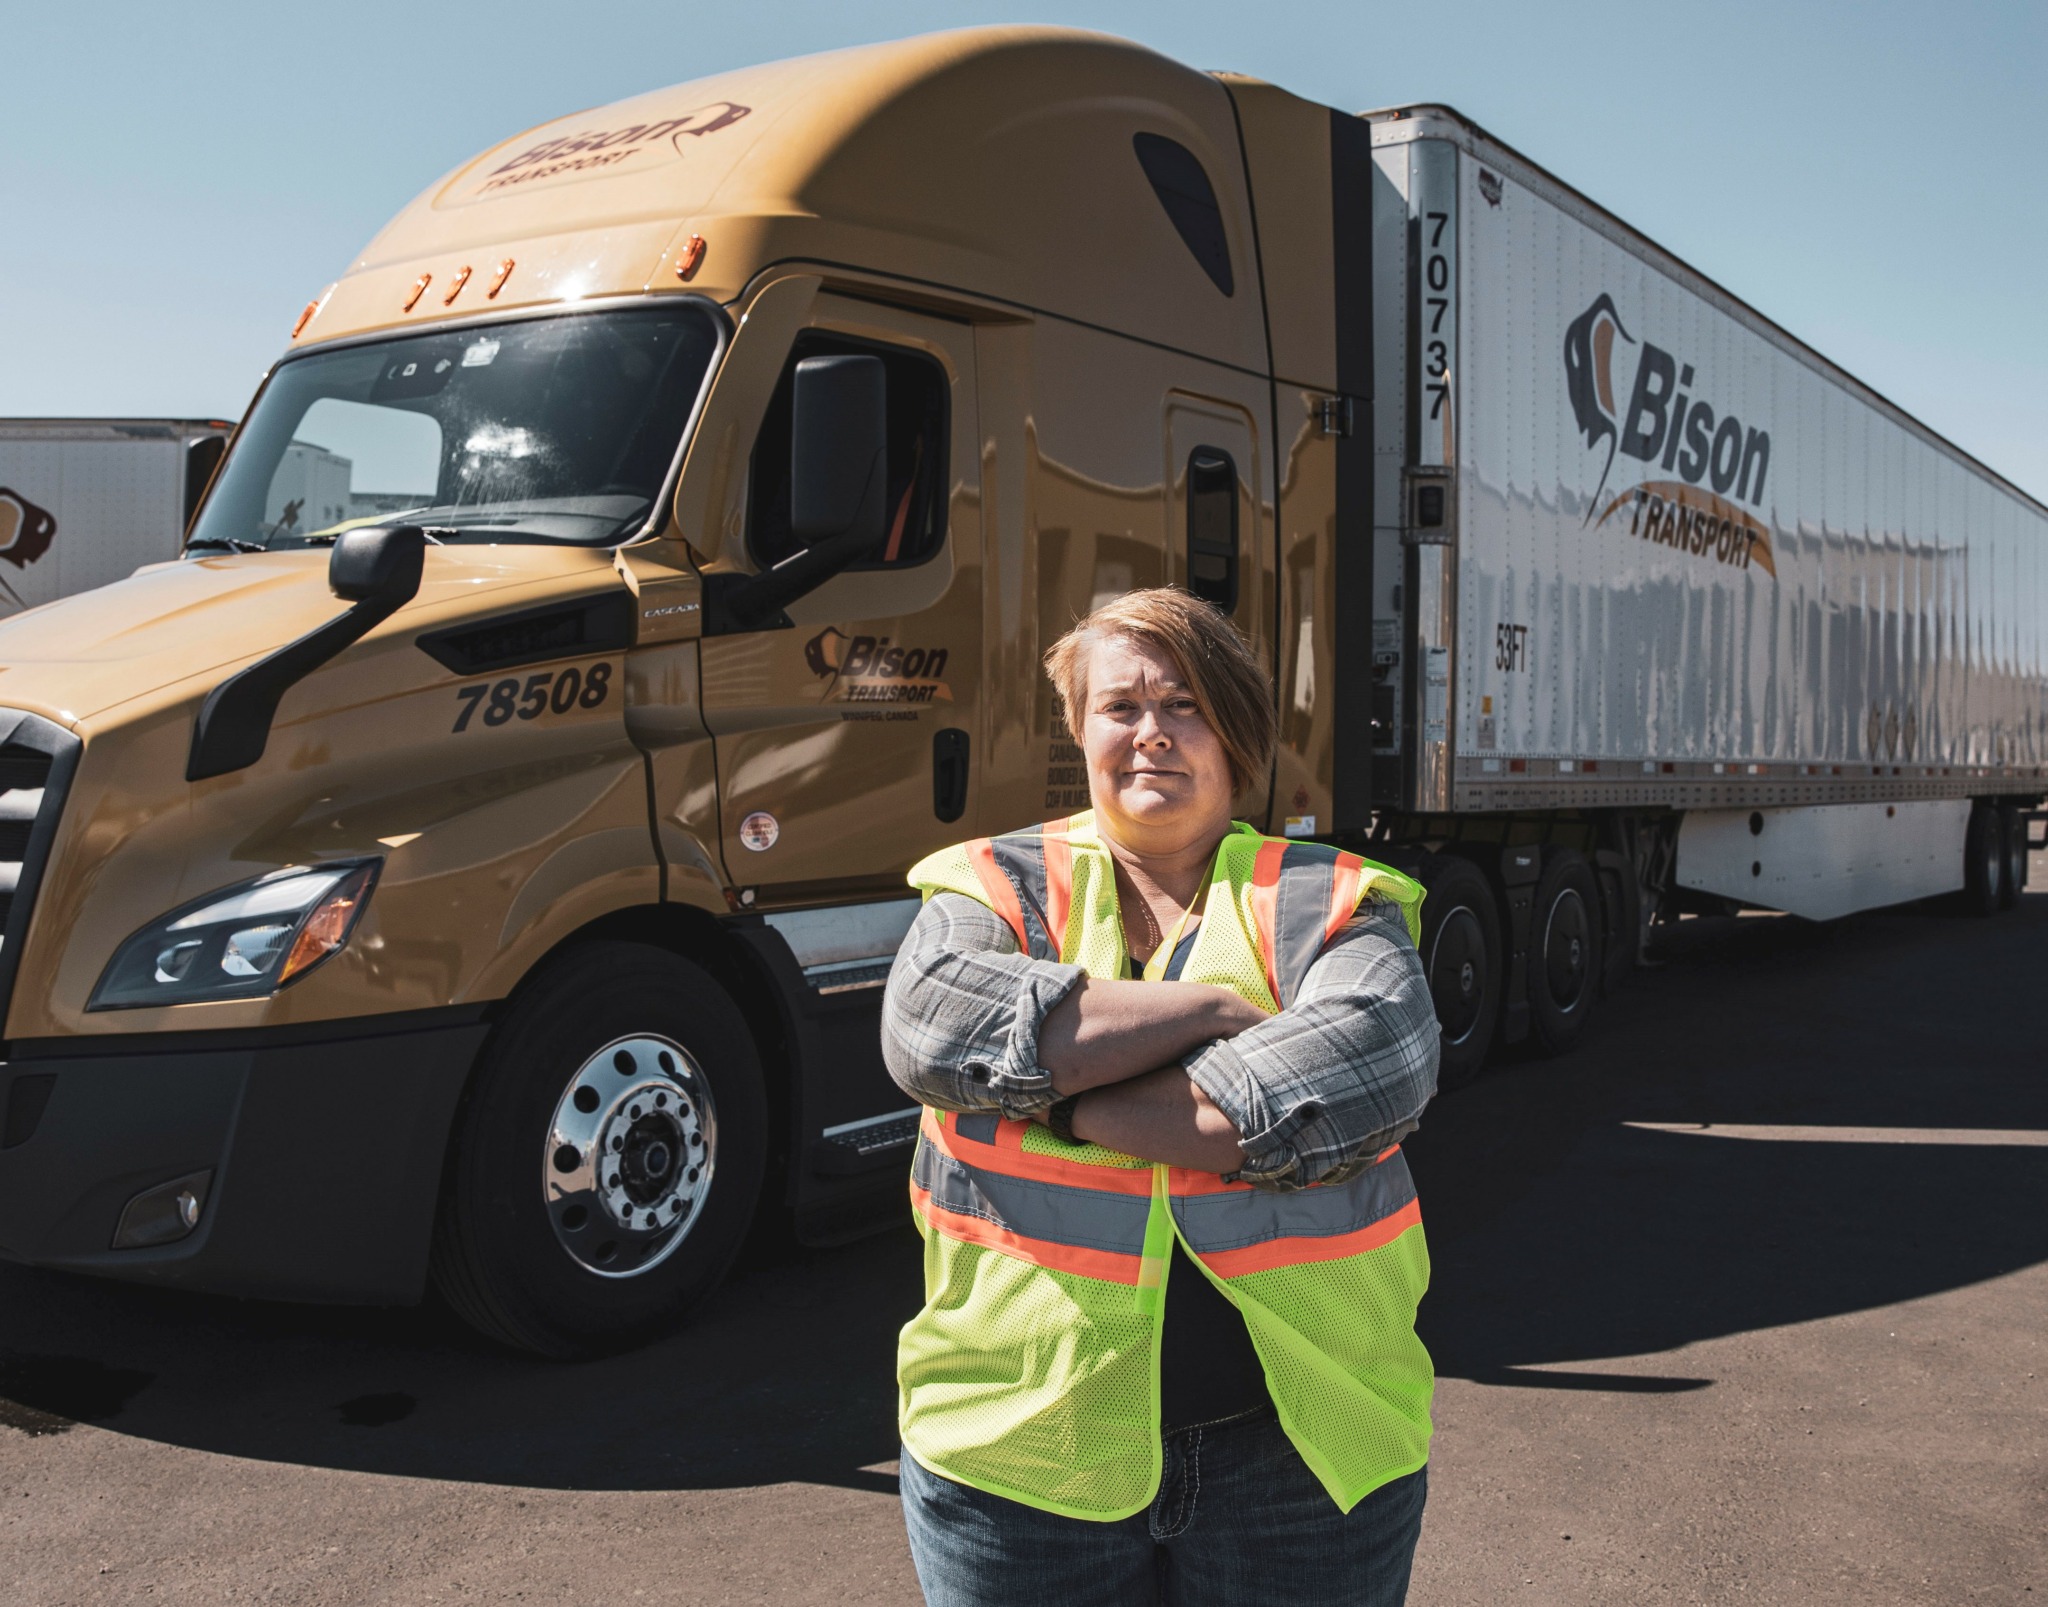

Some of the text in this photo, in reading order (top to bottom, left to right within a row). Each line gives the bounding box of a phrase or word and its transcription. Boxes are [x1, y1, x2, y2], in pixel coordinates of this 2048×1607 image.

[1425, 212, 1449, 420] 70737
[1619, 341, 1771, 507] Bison
[1630, 487, 1757, 570] TRANSPORT
[644, 603, 700, 618] CASCADIA
[840, 636, 948, 679] Bison
[1496, 623, 1527, 673] 53FT
[452, 662, 612, 734] 78508
[847, 685, 938, 702] TRANSPORT
[886, 711, 918, 721] CANADA
[1047, 767, 1077, 786] BONDED
